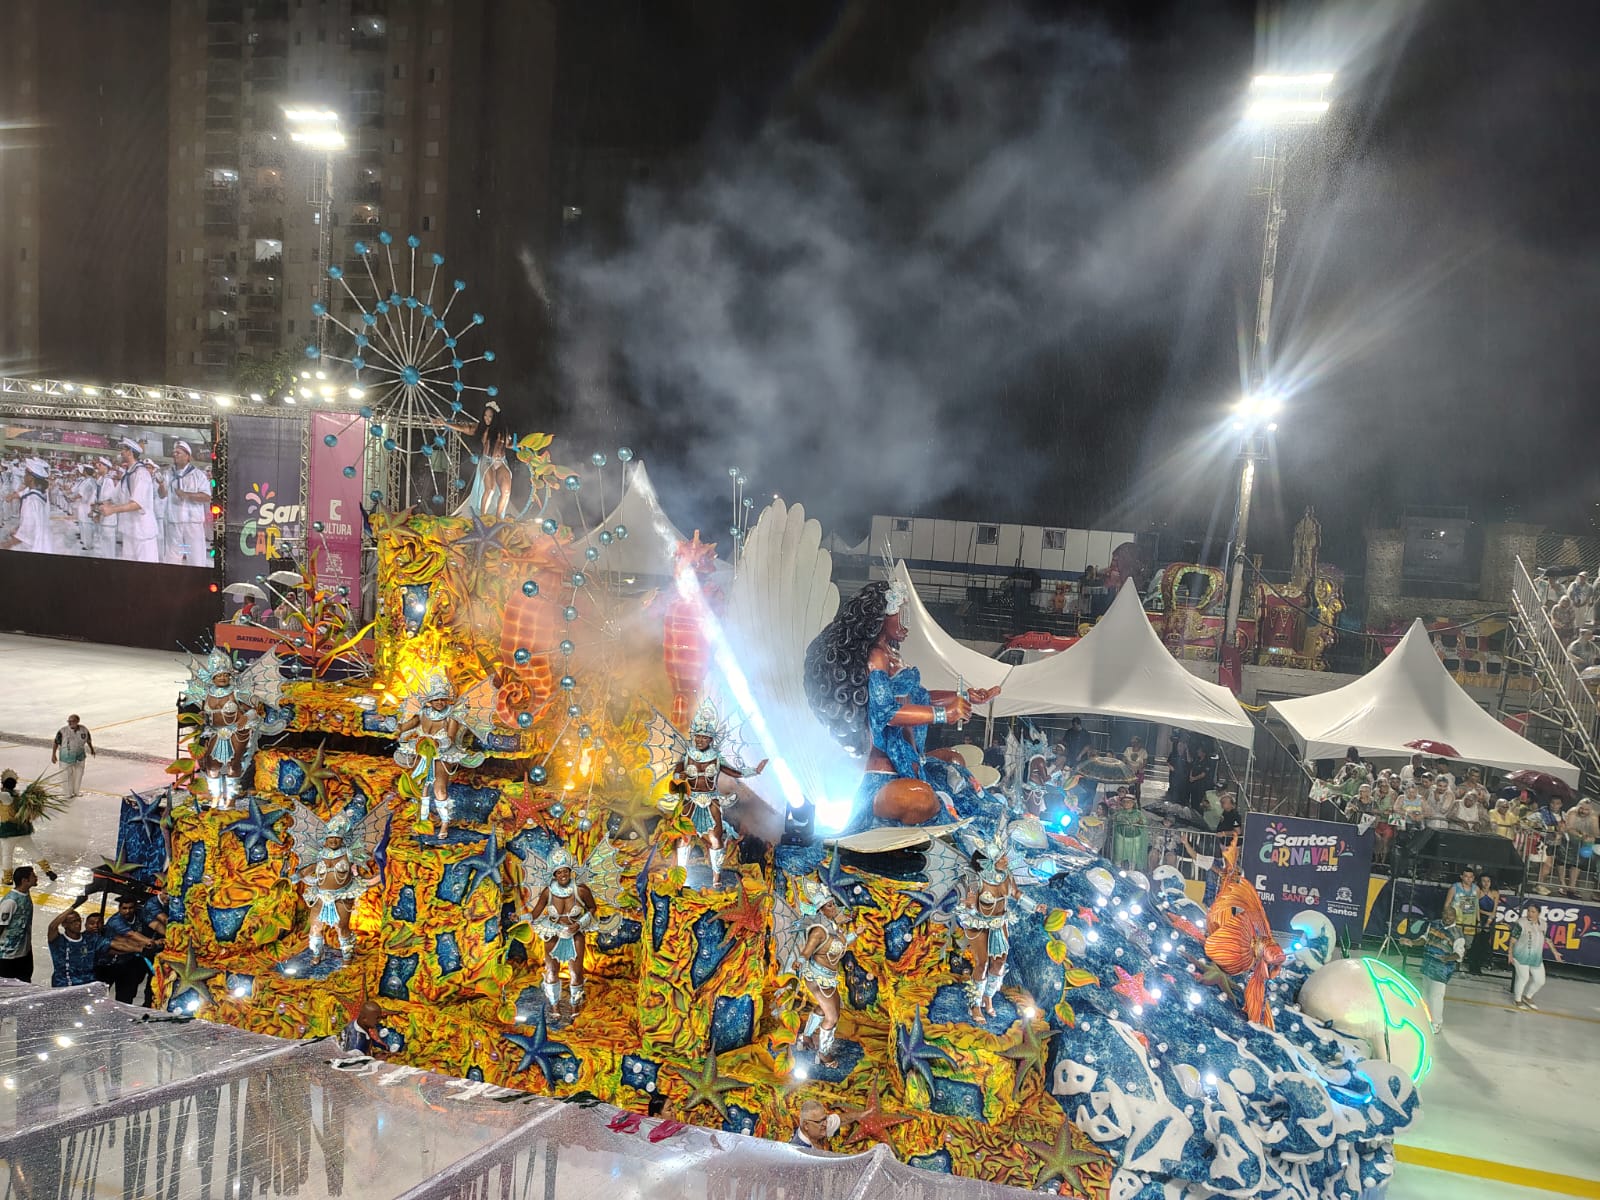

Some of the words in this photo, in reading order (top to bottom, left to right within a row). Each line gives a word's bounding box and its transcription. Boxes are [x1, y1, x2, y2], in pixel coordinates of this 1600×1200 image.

[321, 521, 352, 536] ULTURA
[1274, 834, 1338, 847] Santos
[1259, 842, 1339, 867] CARNAVAL
[1257, 891, 1275, 902] TURA
[1282, 883, 1321, 898] LIGA
[1282, 892, 1320, 905] SANTOS
[1327, 906, 1357, 917] Santos
[1495, 906, 1579, 922] Satos
